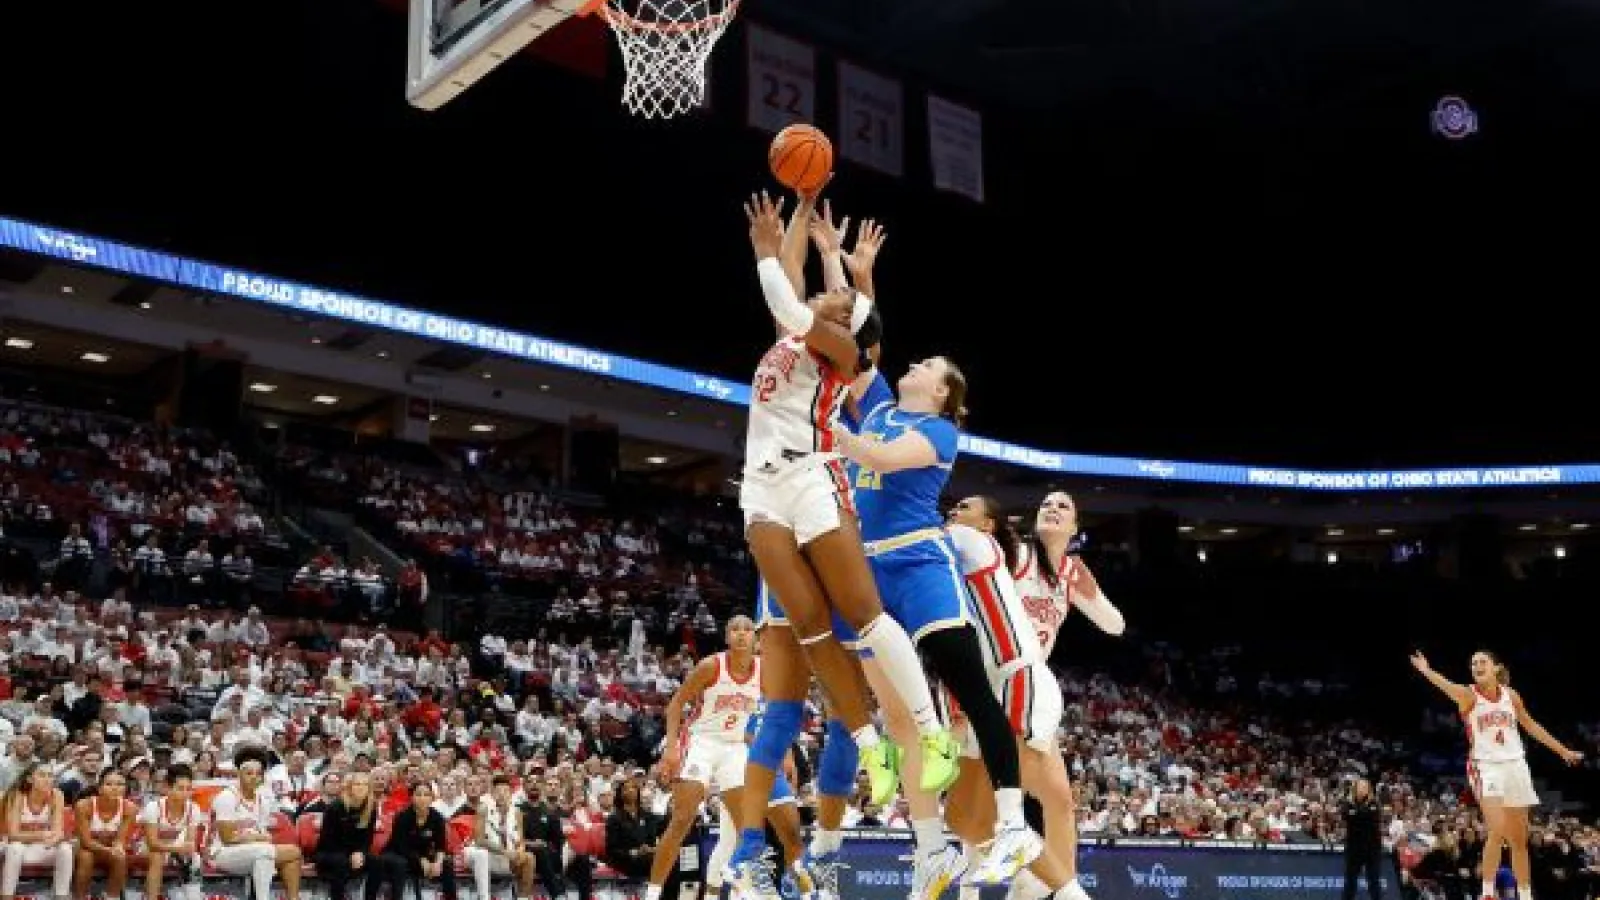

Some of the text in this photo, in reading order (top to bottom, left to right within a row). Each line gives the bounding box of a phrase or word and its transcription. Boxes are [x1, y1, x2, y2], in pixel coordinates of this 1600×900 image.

[763, 73, 802, 115] 22
[855, 110, 888, 148] 21
[223, 271, 611, 372] PROUD SPONSOR OF OHIO STATE ATHLETICS
[1248, 467, 1560, 488] PROUD SPONSOR OF OHIO STATE ATHLETICS
[724, 713, 738, 730] 2
[1494, 729, 1505, 746] 4
[856, 870, 900, 885] PROUD
